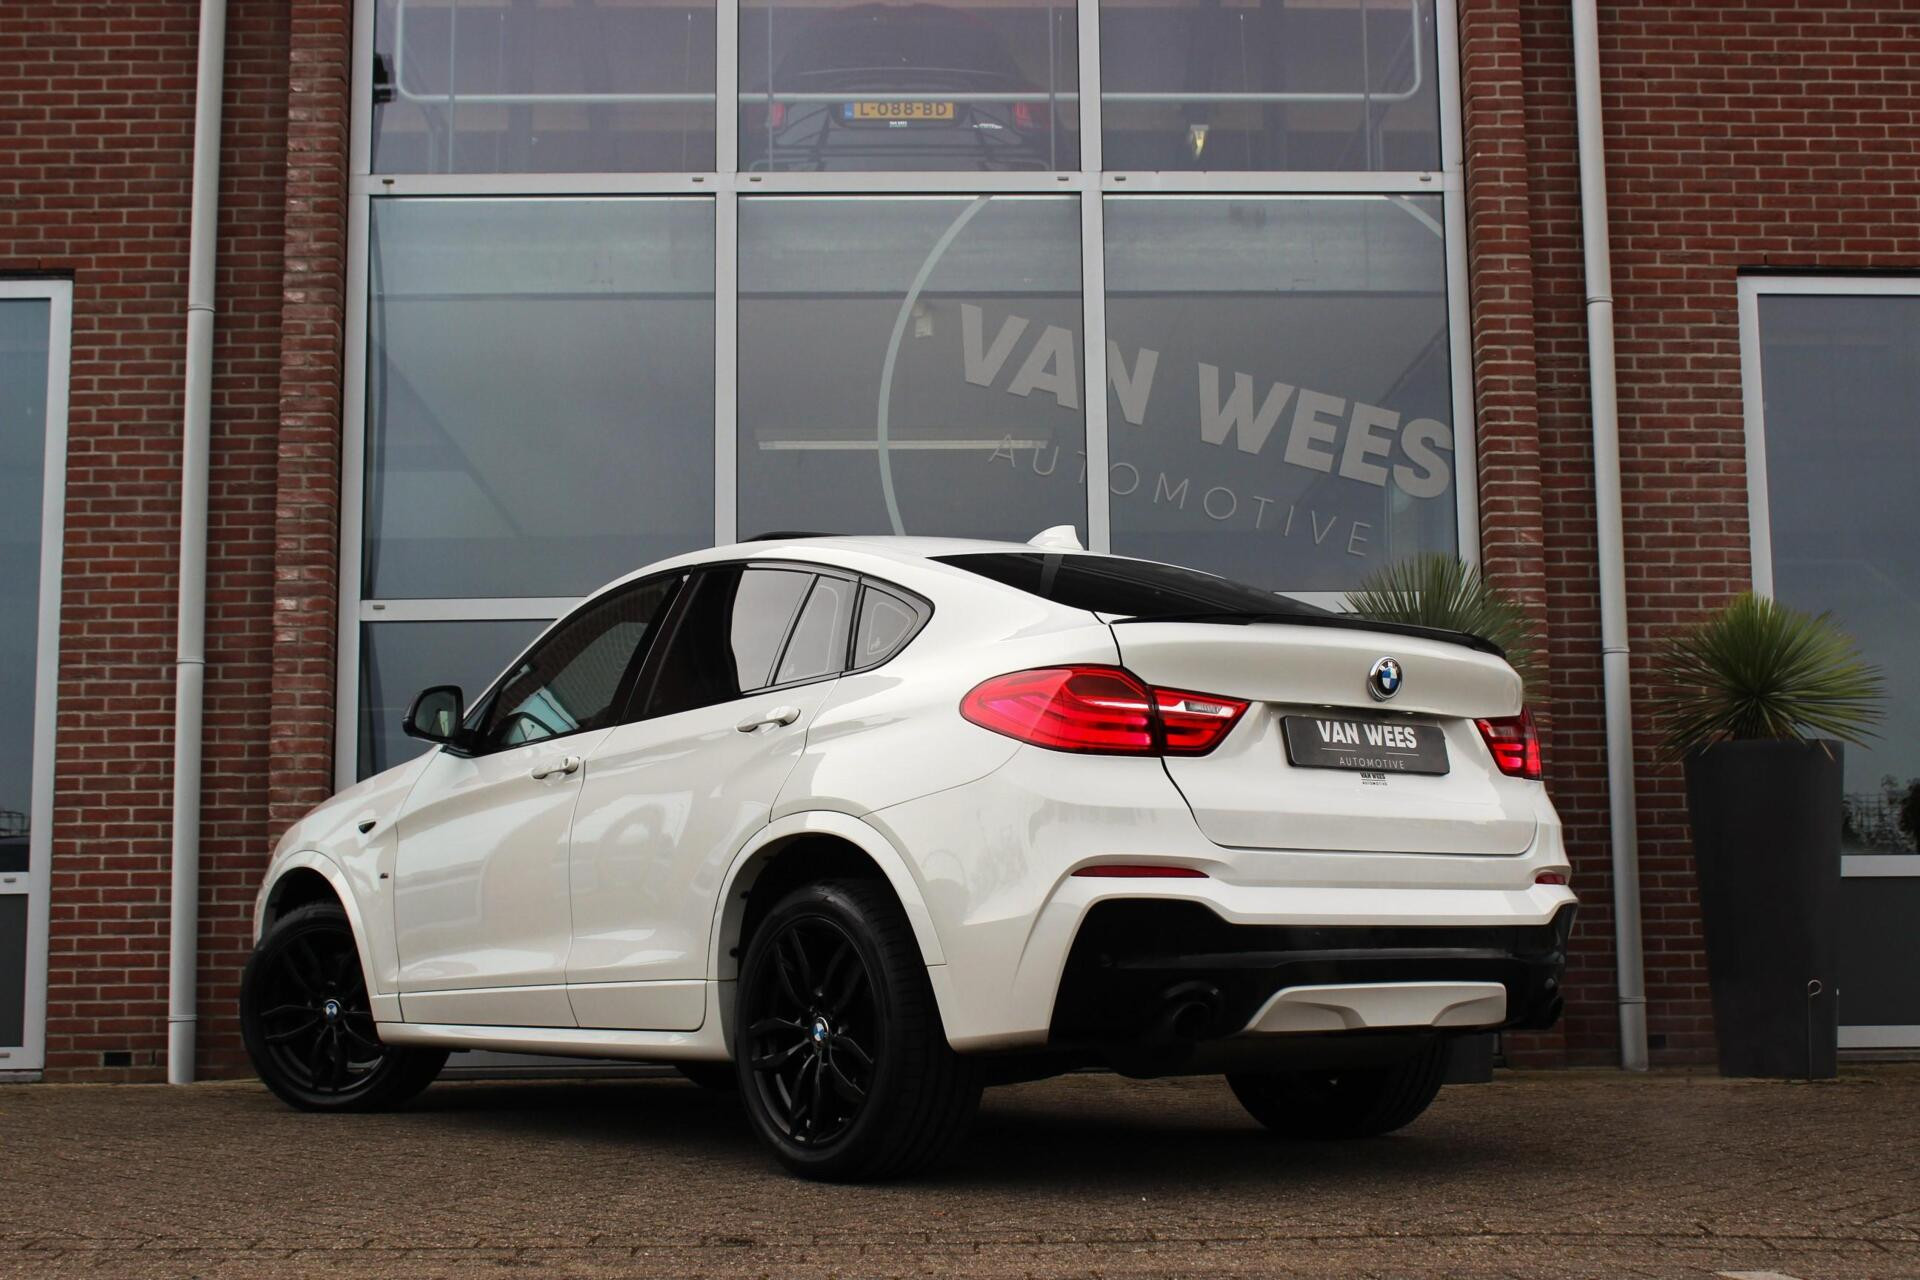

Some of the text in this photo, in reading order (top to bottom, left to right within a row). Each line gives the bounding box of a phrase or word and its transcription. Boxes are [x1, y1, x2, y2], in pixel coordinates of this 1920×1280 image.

[860, 102, 947, 116] L-088-BD
[961, 303, 1453, 499] VAN WEES
[988, 433, 1372, 557] AUTOMOTIVE
[1316, 720, 1418, 749] VAN WEES
[1339, 756, 1405, 769] AUTOMOTIVE
